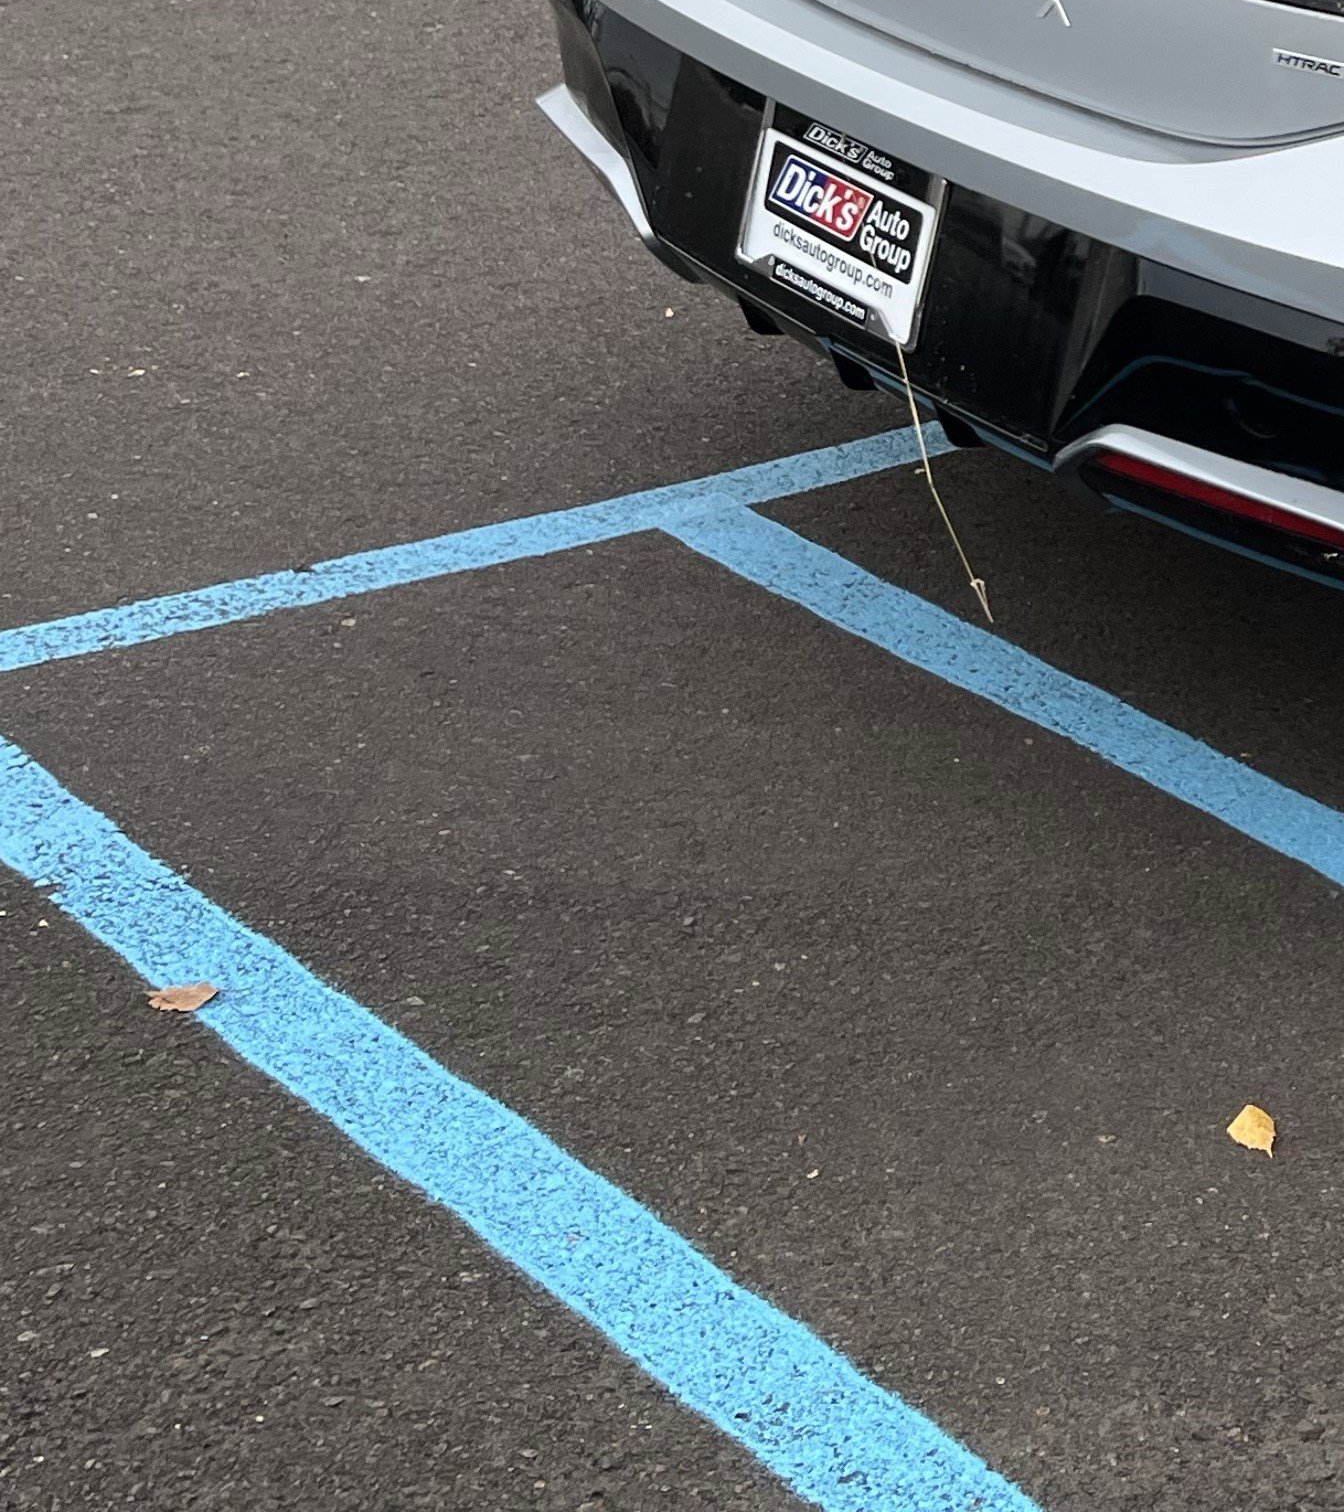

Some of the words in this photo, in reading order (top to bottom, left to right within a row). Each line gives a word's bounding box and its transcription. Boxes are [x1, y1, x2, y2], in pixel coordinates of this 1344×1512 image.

[1277, 53, 1341, 77] HTRAC
[808, 125, 865, 161] Dick's
[868, 150, 893, 169] Auto
[775, 163, 860, 231] Dick's
[866, 199, 910, 240] Auto
[773, 221, 893, 299] dicksautogroup.com
[858, 224, 912, 273] Group
[774, 263, 866, 320] dicksautogroup.com
